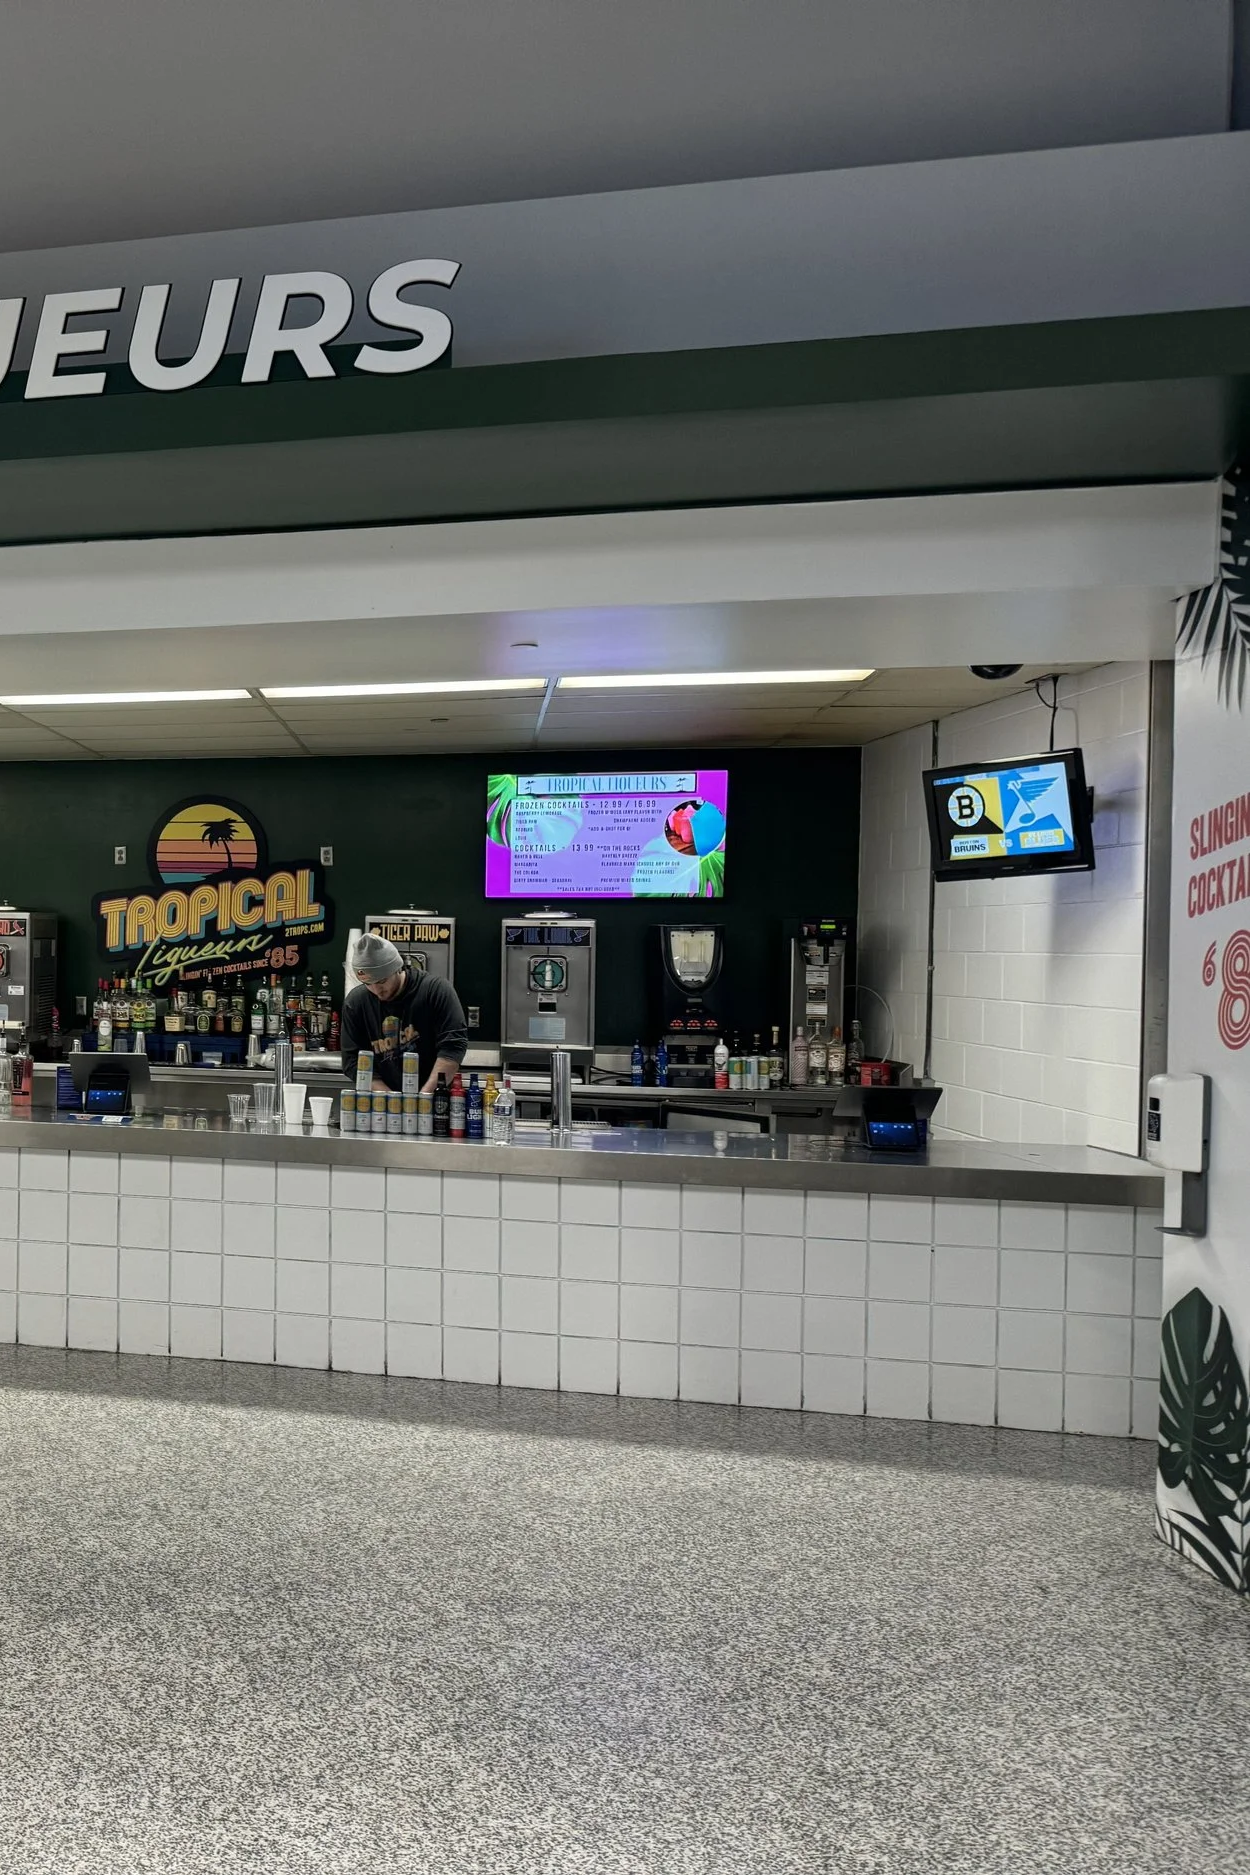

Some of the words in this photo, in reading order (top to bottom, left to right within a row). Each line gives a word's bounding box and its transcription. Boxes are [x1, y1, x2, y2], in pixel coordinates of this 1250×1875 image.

[548, 777, 604, 792] TROPICAL
[608, 776, 667, 792] LIQUEURS
[515, 801, 545, 810] FROZEN
[547, 800, 589, 809] COCKTAILS
[600, 800, 622, 808] 12.99
[956, 795, 975, 820] B
[514, 844, 557, 852] COCKTAILS
[954, 843, 986, 853] BRUINS
[100, 868, 325, 952] TROPICAL
[285, 922, 325, 938] 2TROPS.COM
[379, 923, 410, 941] TIGER
[414, 924, 439, 942] PAW
[134, 931, 274, 986] Liqueurs
[223, 961, 252, 974] COCKTAILS
[253, 958, 269, 969] SINCE
[264, 944, 300, 969] ‘85
